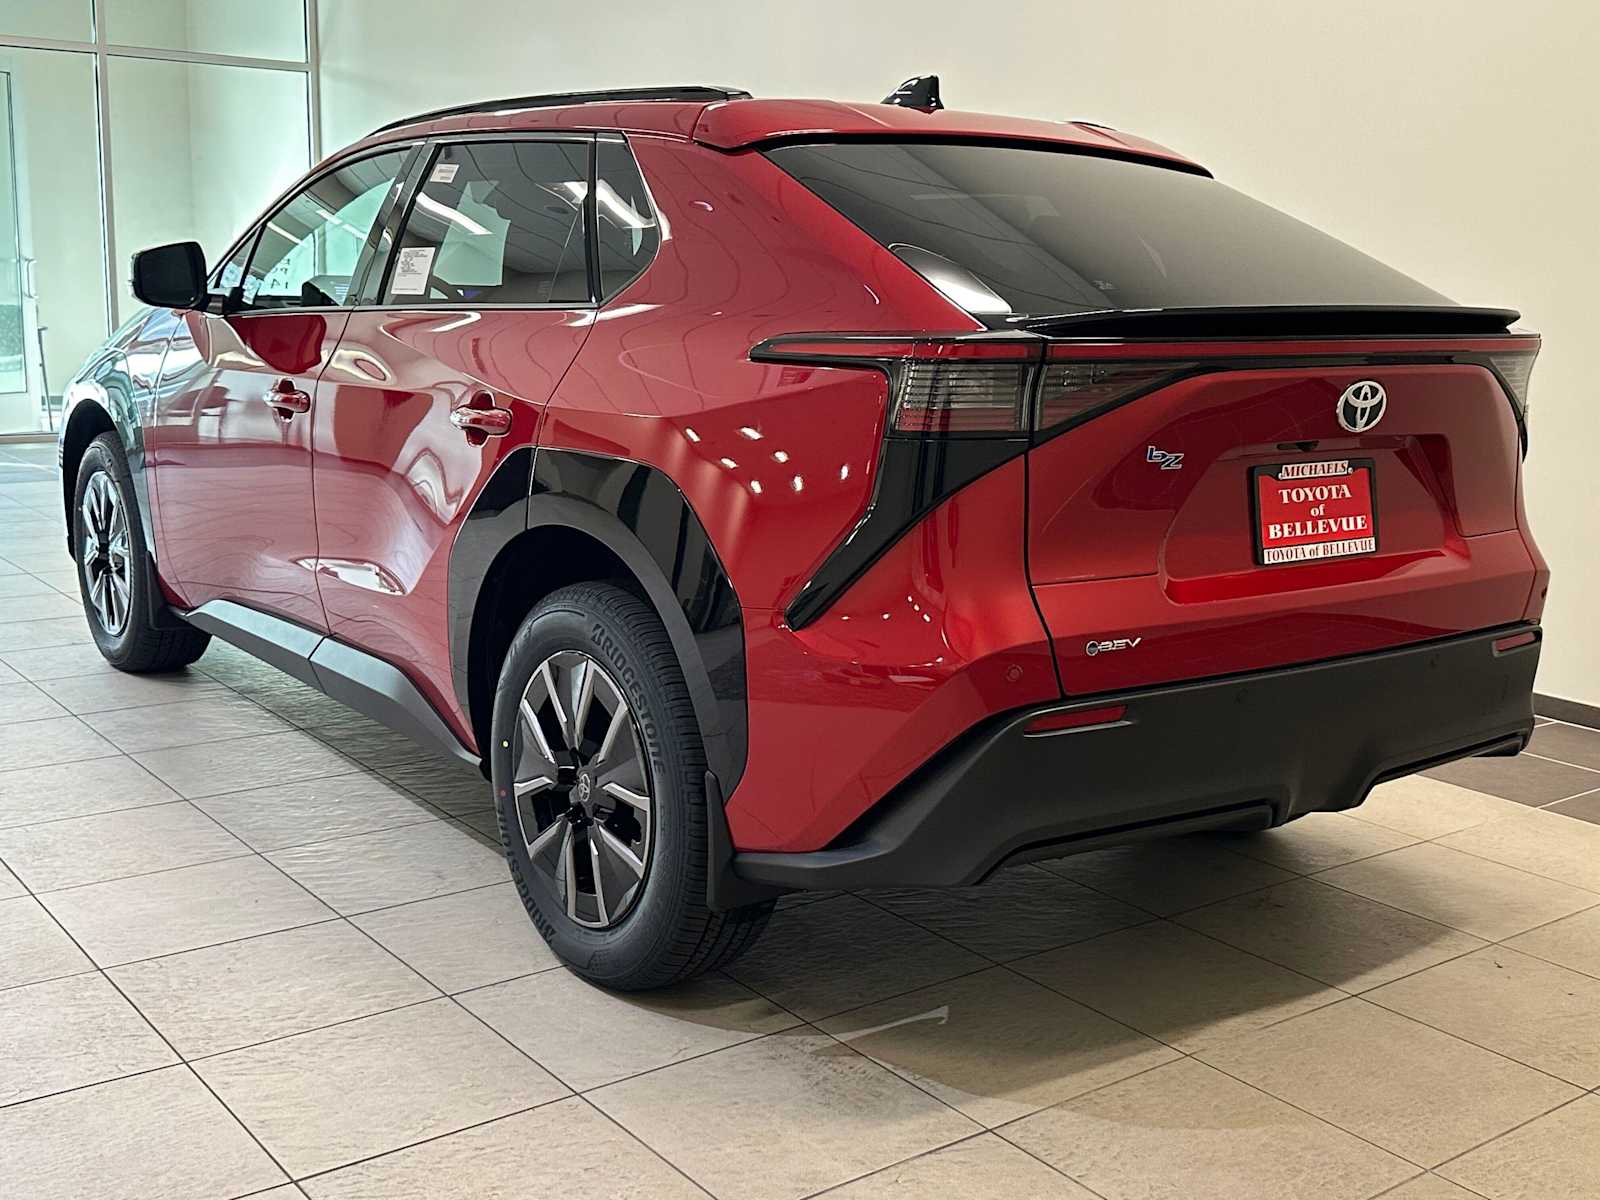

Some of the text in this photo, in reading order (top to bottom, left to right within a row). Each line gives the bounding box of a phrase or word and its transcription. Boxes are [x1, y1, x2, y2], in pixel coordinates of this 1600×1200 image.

[1281, 461, 1347, 478] MICHAELS
[1278, 484, 1352, 504] TOYOTA
[1310, 503, 1325, 516] of
[1268, 515, 1368, 539] BELLEVUE
[1265, 539, 1374, 562] TOYOTA of BELLEVUE
[590, 623, 666, 776] BRIDGESTONE
